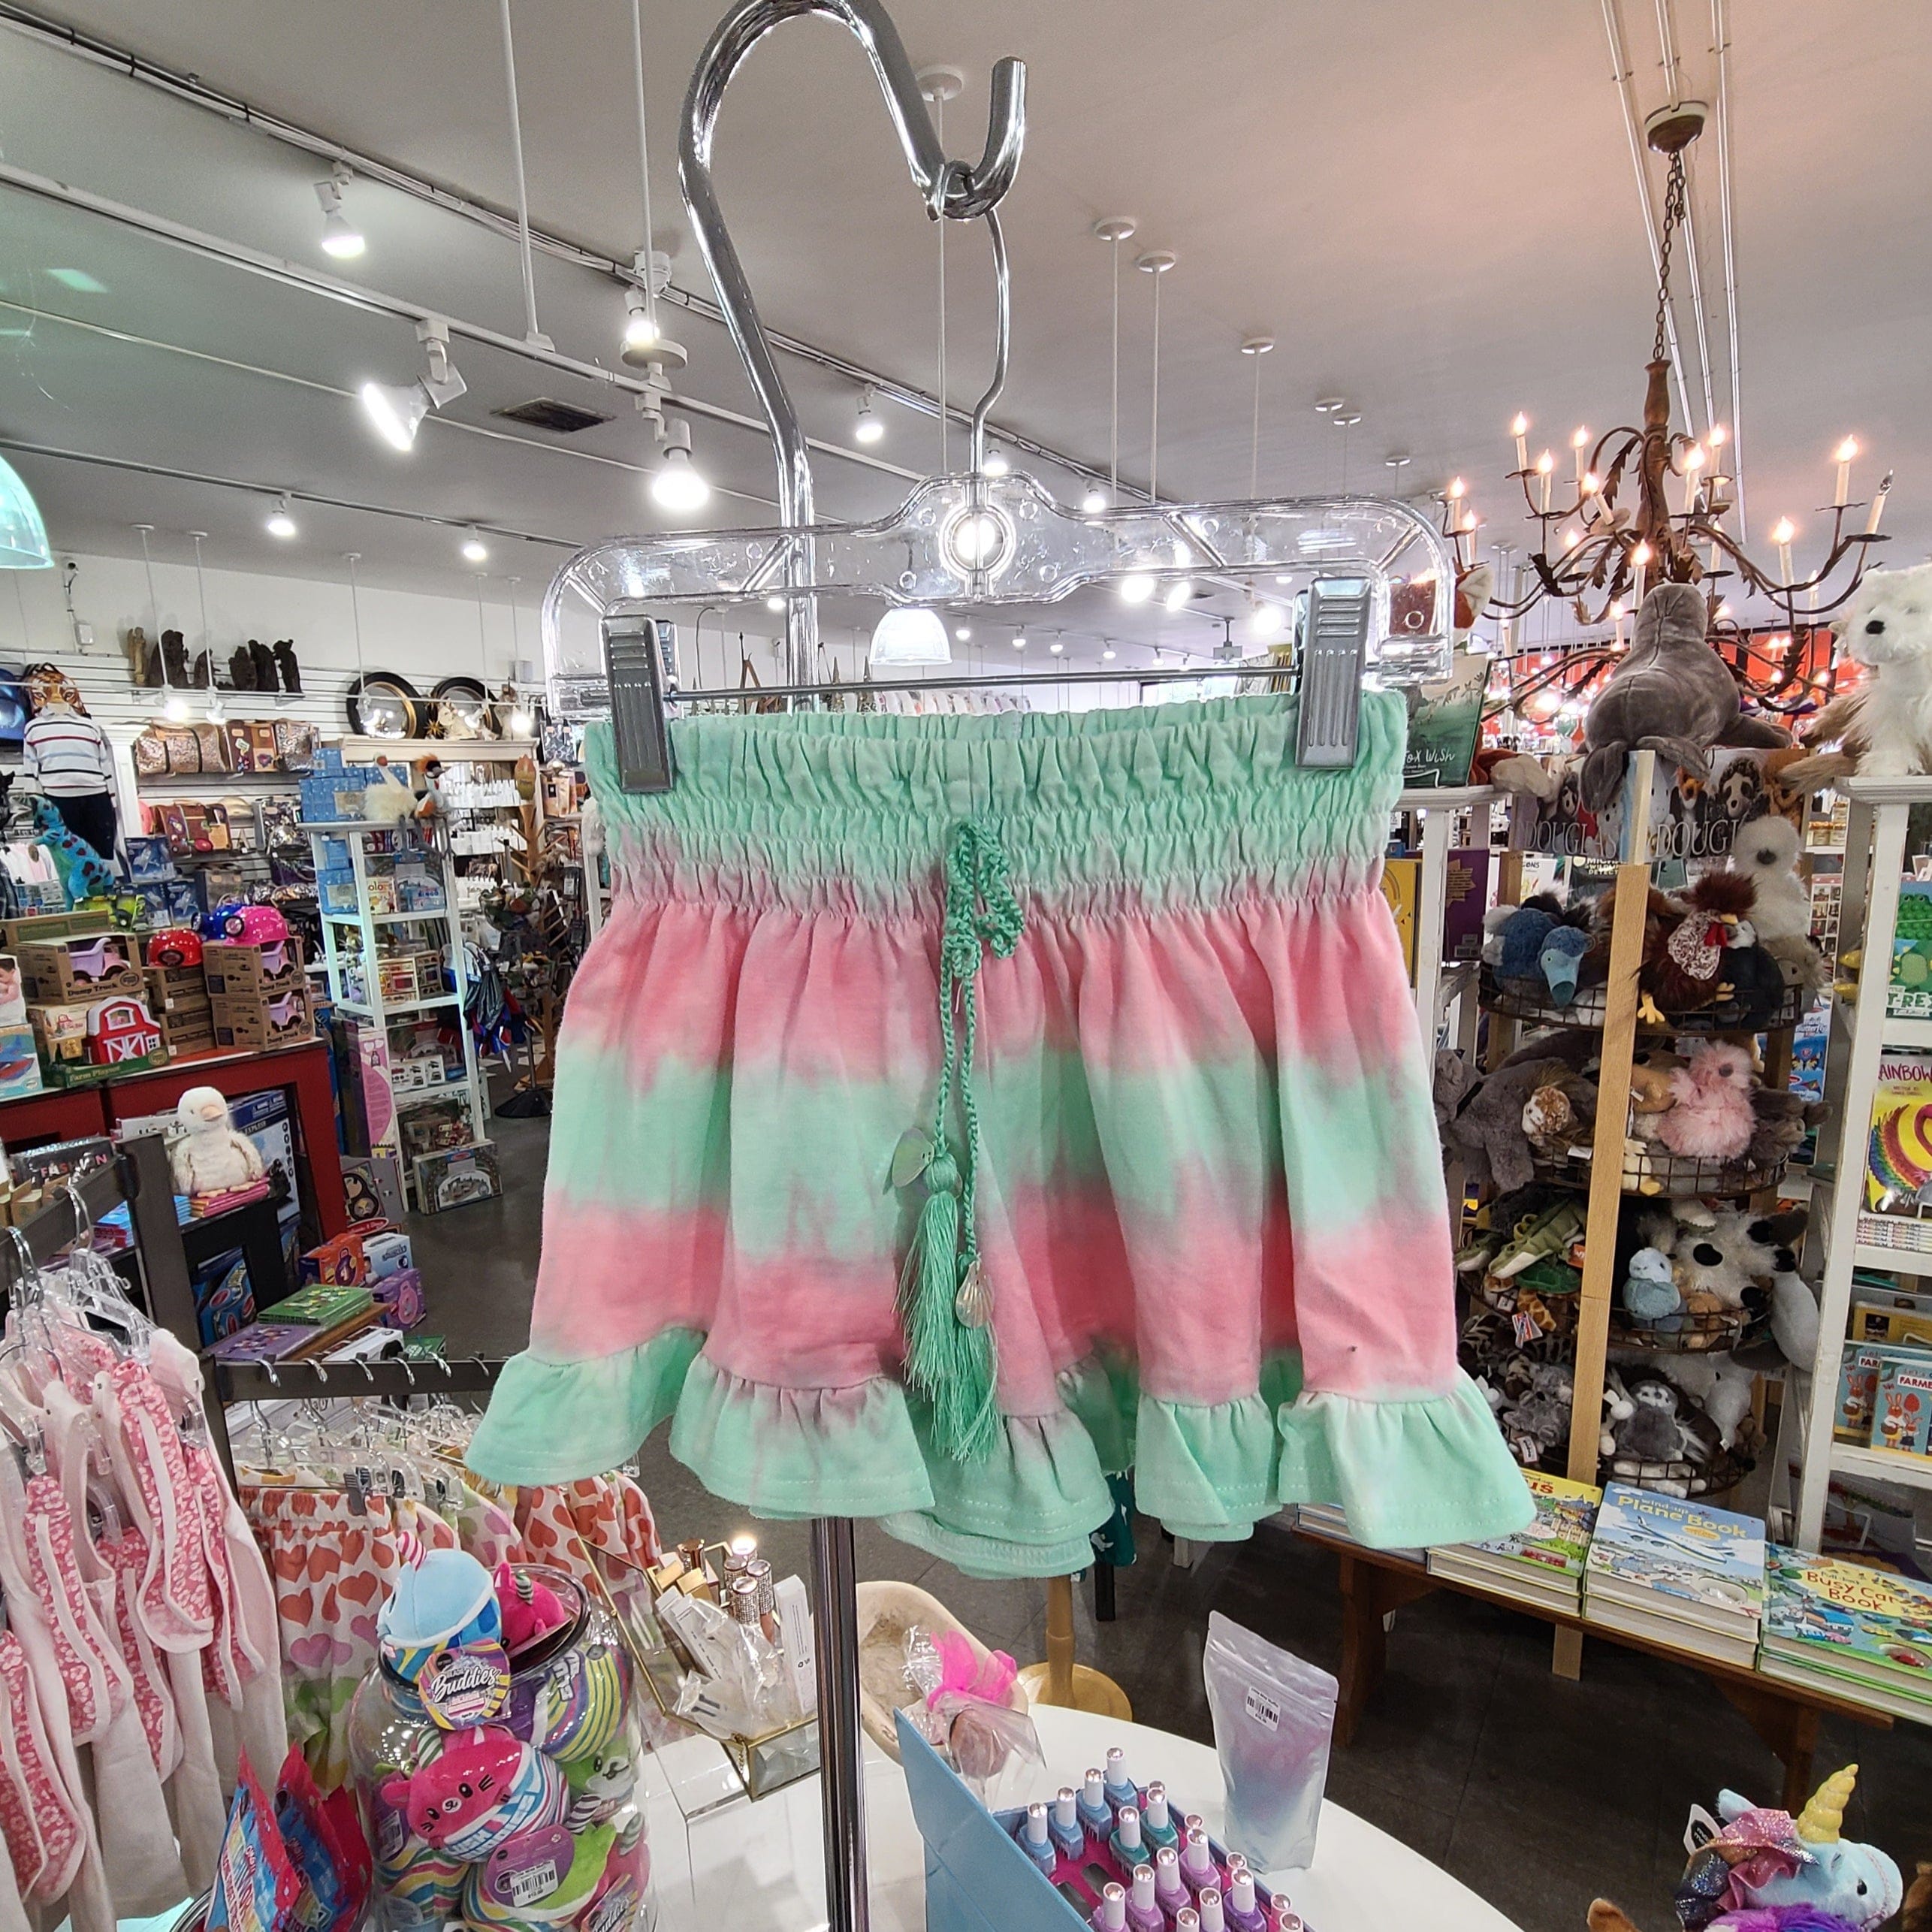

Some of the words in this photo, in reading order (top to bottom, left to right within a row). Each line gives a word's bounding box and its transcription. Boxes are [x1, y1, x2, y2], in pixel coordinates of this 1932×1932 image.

[1523, 820, 1617, 859] DOUGLAS
[93, 983, 119, 992] Truck
[69, 1071, 92, 1082] Farm
[1878, 1063, 1932, 1083] AINBOW
[1617, 1494, 1684, 1523] Plane
[1687, 1513, 1747, 1538] Book
[1807, 1571, 1855, 1594] Busy
[1860, 1586, 1900, 1604] Car
[1828, 1587, 1885, 1613] Book
[431, 1665, 502, 1704] Buddies
